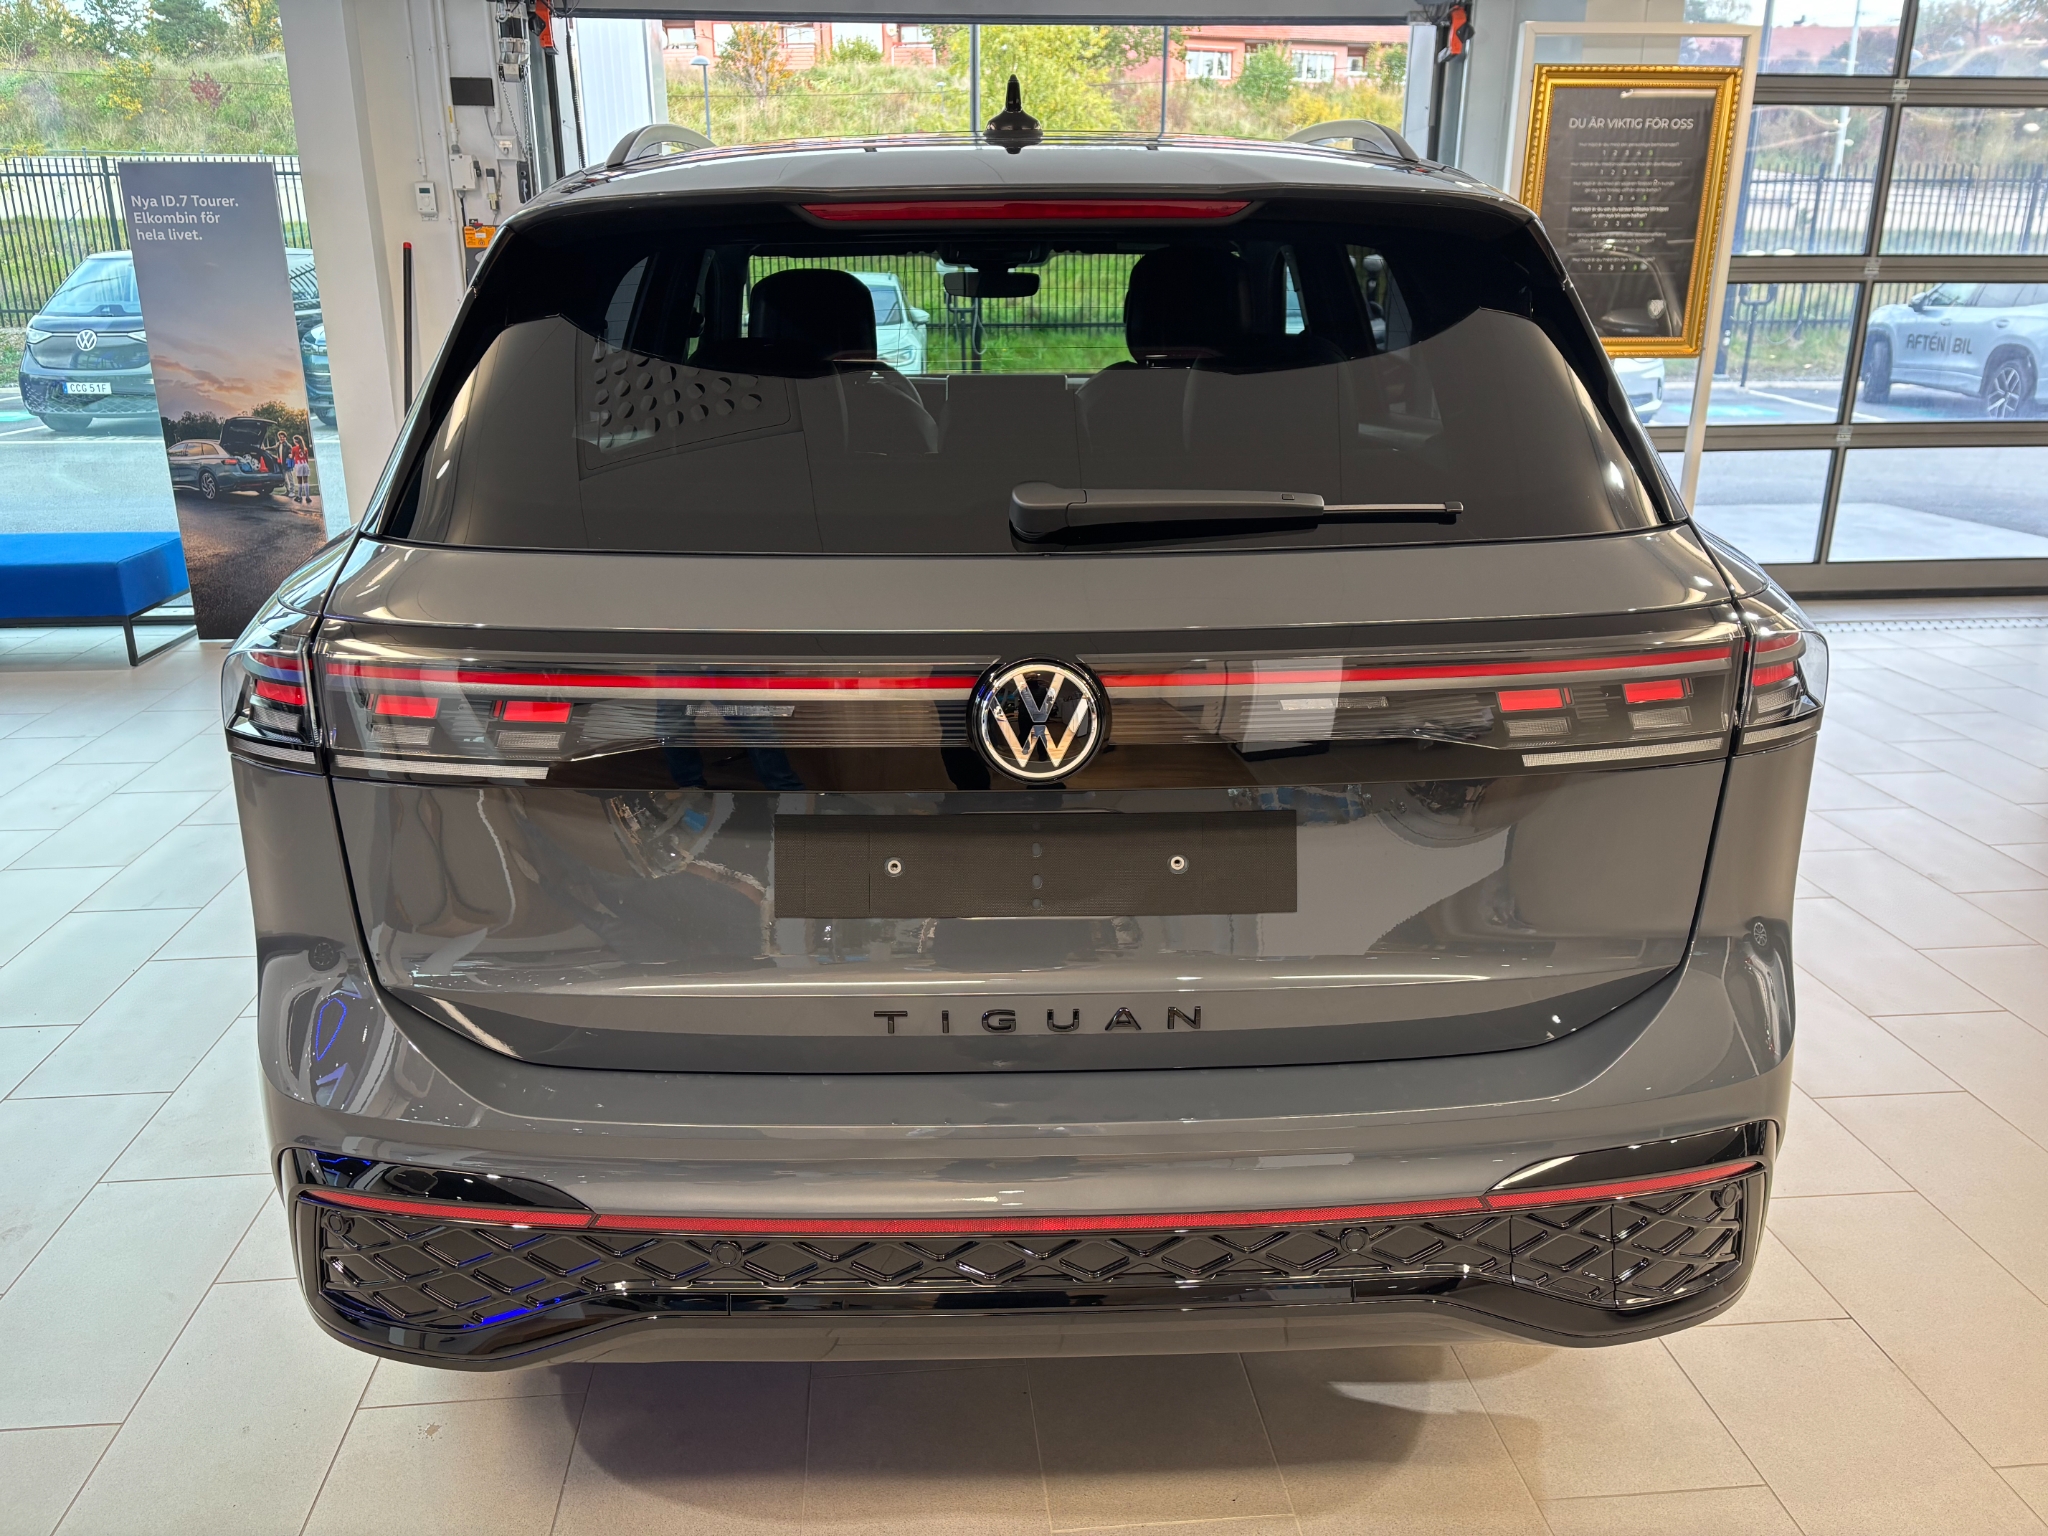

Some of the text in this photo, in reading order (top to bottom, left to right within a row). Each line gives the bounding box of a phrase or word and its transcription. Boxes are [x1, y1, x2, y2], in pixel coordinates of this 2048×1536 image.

[1568, 116, 1694, 130] DU ÄR VIKTIG FÖR OSS
[130, 195, 239, 210] Nya ID.7 Tourer.
[133, 211, 220, 224] Elkombin för
[136, 228, 203, 240] hela livet.
[1906, 331, 1973, 355] AFTÉN BIL
[70, 383, 107, 393] CCG 51F
[984, 667, 1094, 774] VW
[873, 1006, 1202, 1034] TIGUAN
